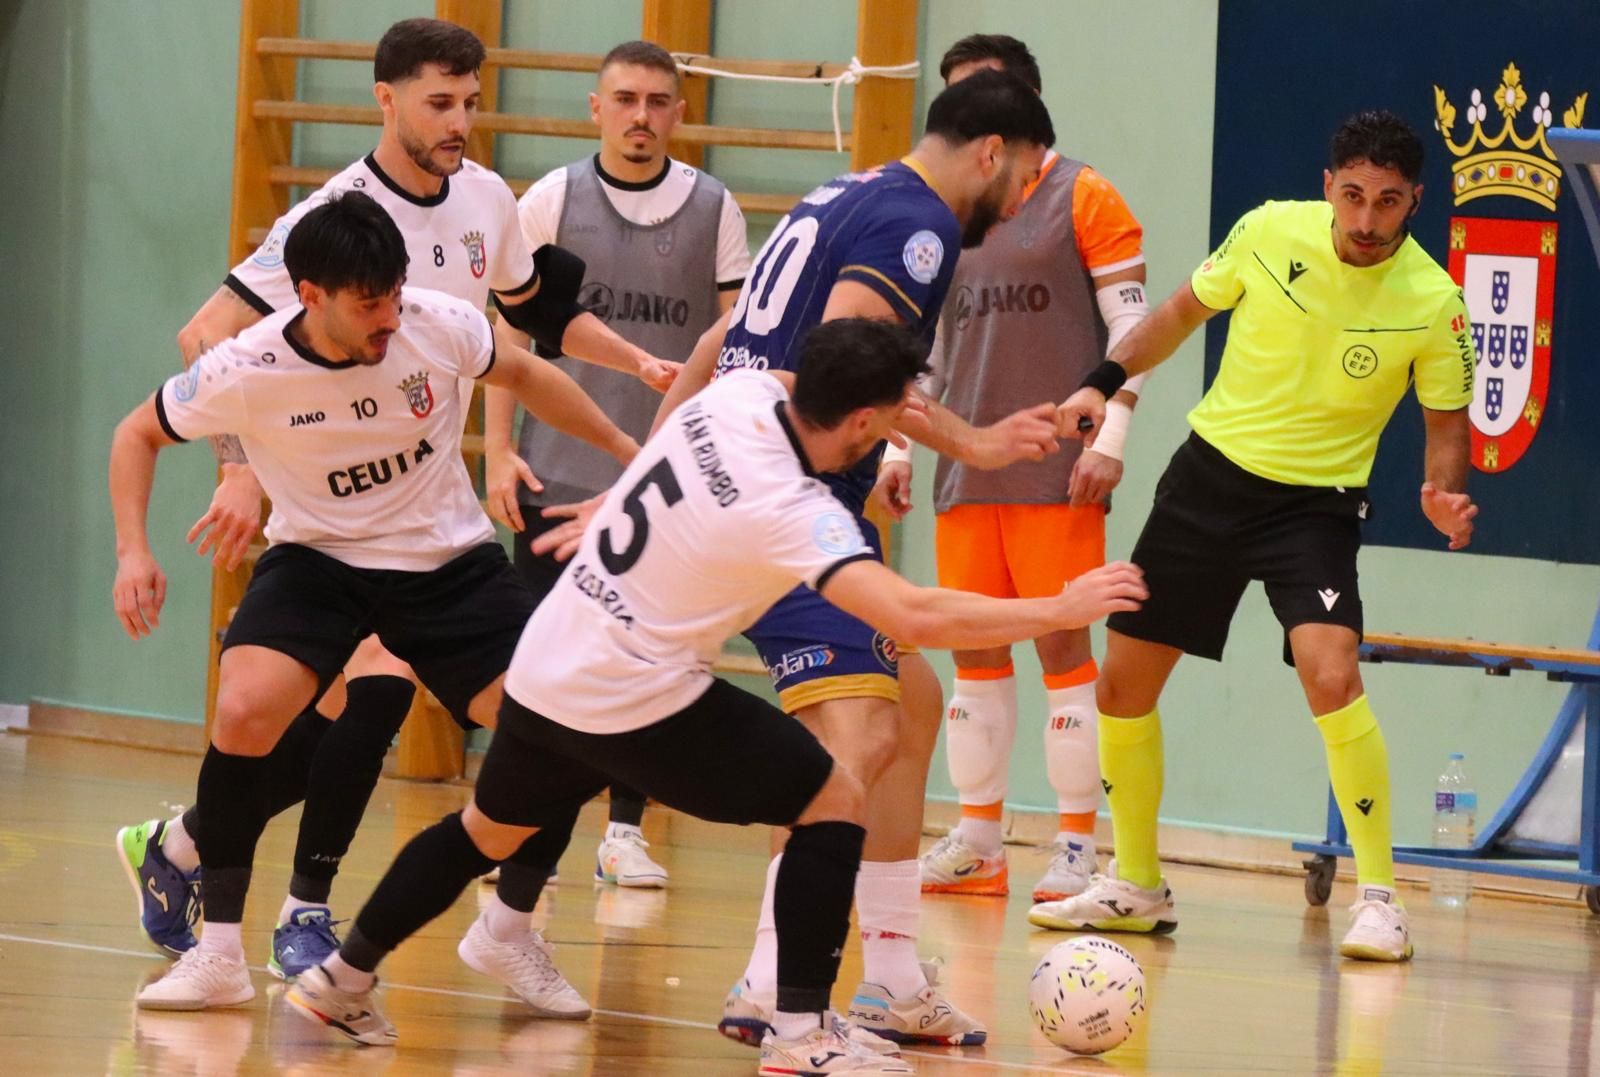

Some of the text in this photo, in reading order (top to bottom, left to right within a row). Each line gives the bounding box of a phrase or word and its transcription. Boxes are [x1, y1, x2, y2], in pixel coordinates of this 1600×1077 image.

[433, 244, 445, 267] 8
[616, 292, 689, 328] JAKO
[977, 284, 1051, 317] JAKO
[289, 411, 326, 427] JAKO
[350, 397, 378, 420] 10
[327, 438, 434, 497] CEUTA
[692, 442, 740, 508] RUMBO
[598, 456, 684, 576] 5
